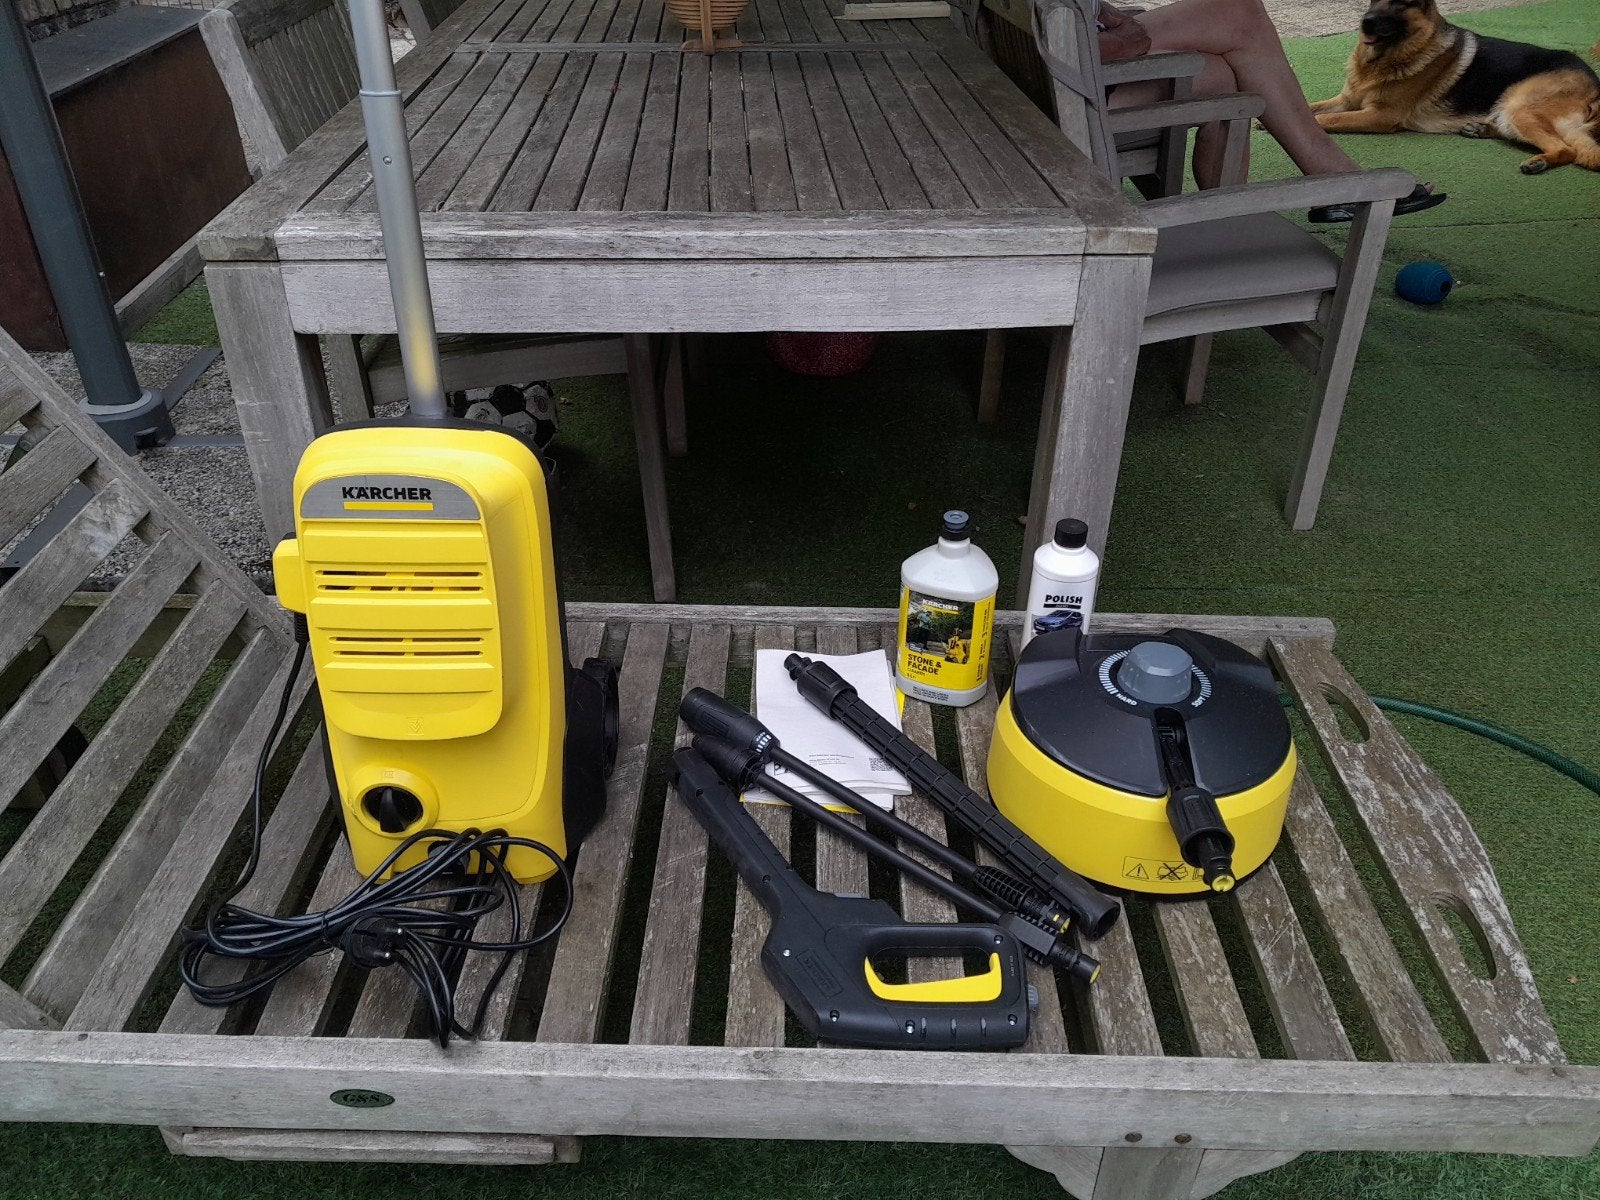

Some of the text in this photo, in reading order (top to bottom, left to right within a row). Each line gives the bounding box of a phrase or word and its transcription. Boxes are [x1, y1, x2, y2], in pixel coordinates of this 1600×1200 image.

[342, 486, 432, 500] KÄRCHER
[1045, 594, 1083, 604] POLISH
[907, 653, 934, 667] STONE
[907, 660, 940, 675] FACADE
[1116, 693, 1137, 706] HARD
[1191, 696, 1207, 708] SOFT
